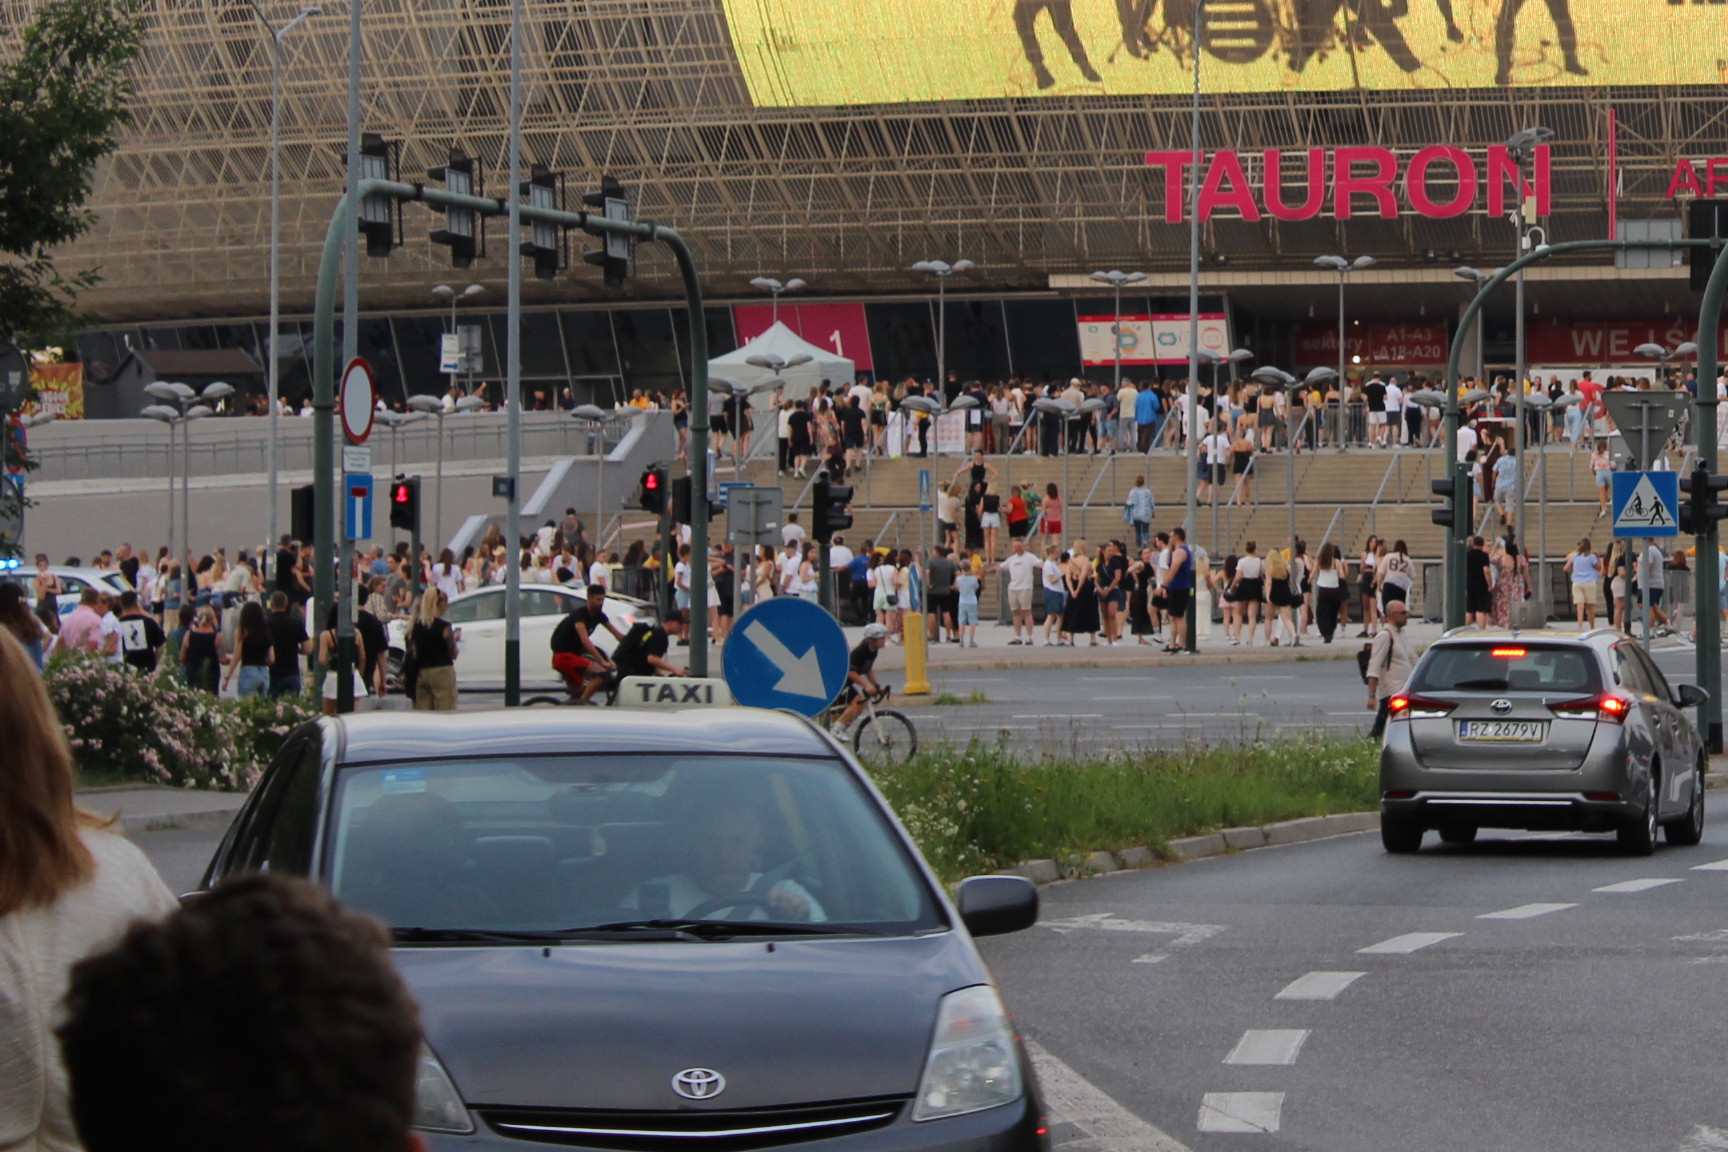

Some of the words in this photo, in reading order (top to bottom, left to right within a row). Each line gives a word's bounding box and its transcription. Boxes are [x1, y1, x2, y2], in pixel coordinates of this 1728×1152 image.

[1145, 145, 1551, 224] TAURON
[829, 329, 843, 356] 1
[1387, 328, 1432, 342] A1-A3
[636, 683, 713, 704] TAXI
[1470, 722, 1489, 736] RZ
[1494, 723, 1538, 737] 2679V
